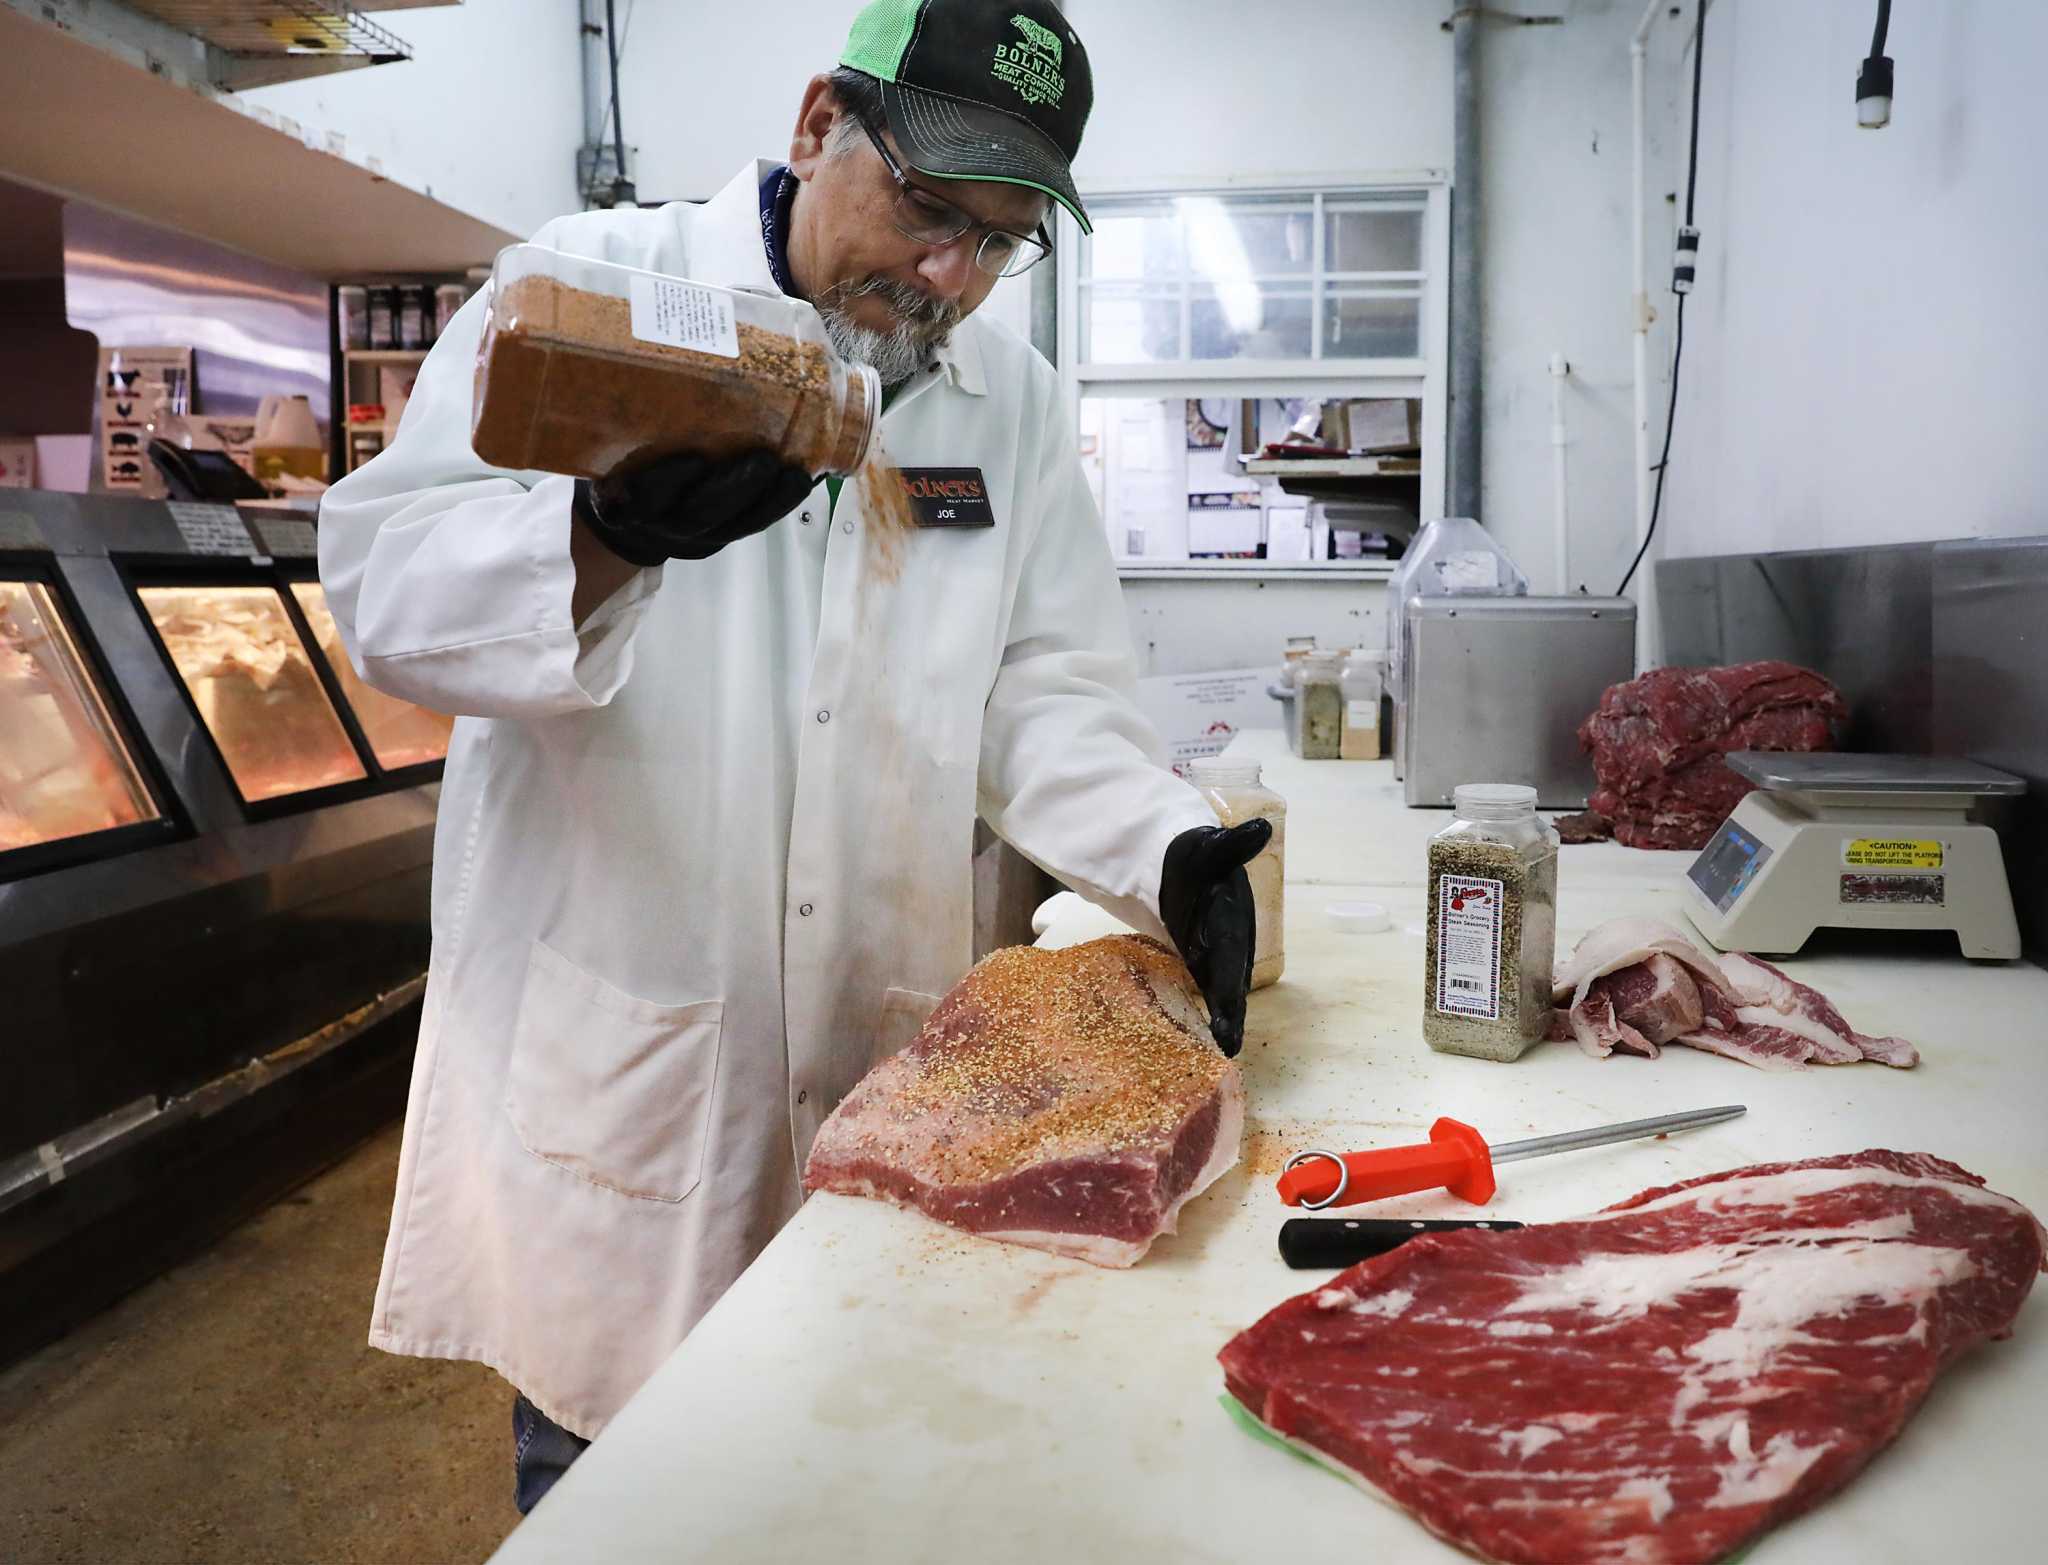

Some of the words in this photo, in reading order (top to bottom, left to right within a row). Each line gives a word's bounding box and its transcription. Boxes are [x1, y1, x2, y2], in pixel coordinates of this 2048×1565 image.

[994, 62, 1021, 77] MEAT
[1024, 74, 1060, 101] COMPANY
[995, 44, 1065, 91] BOLNER'S
[937, 509, 957, 519] JOE
